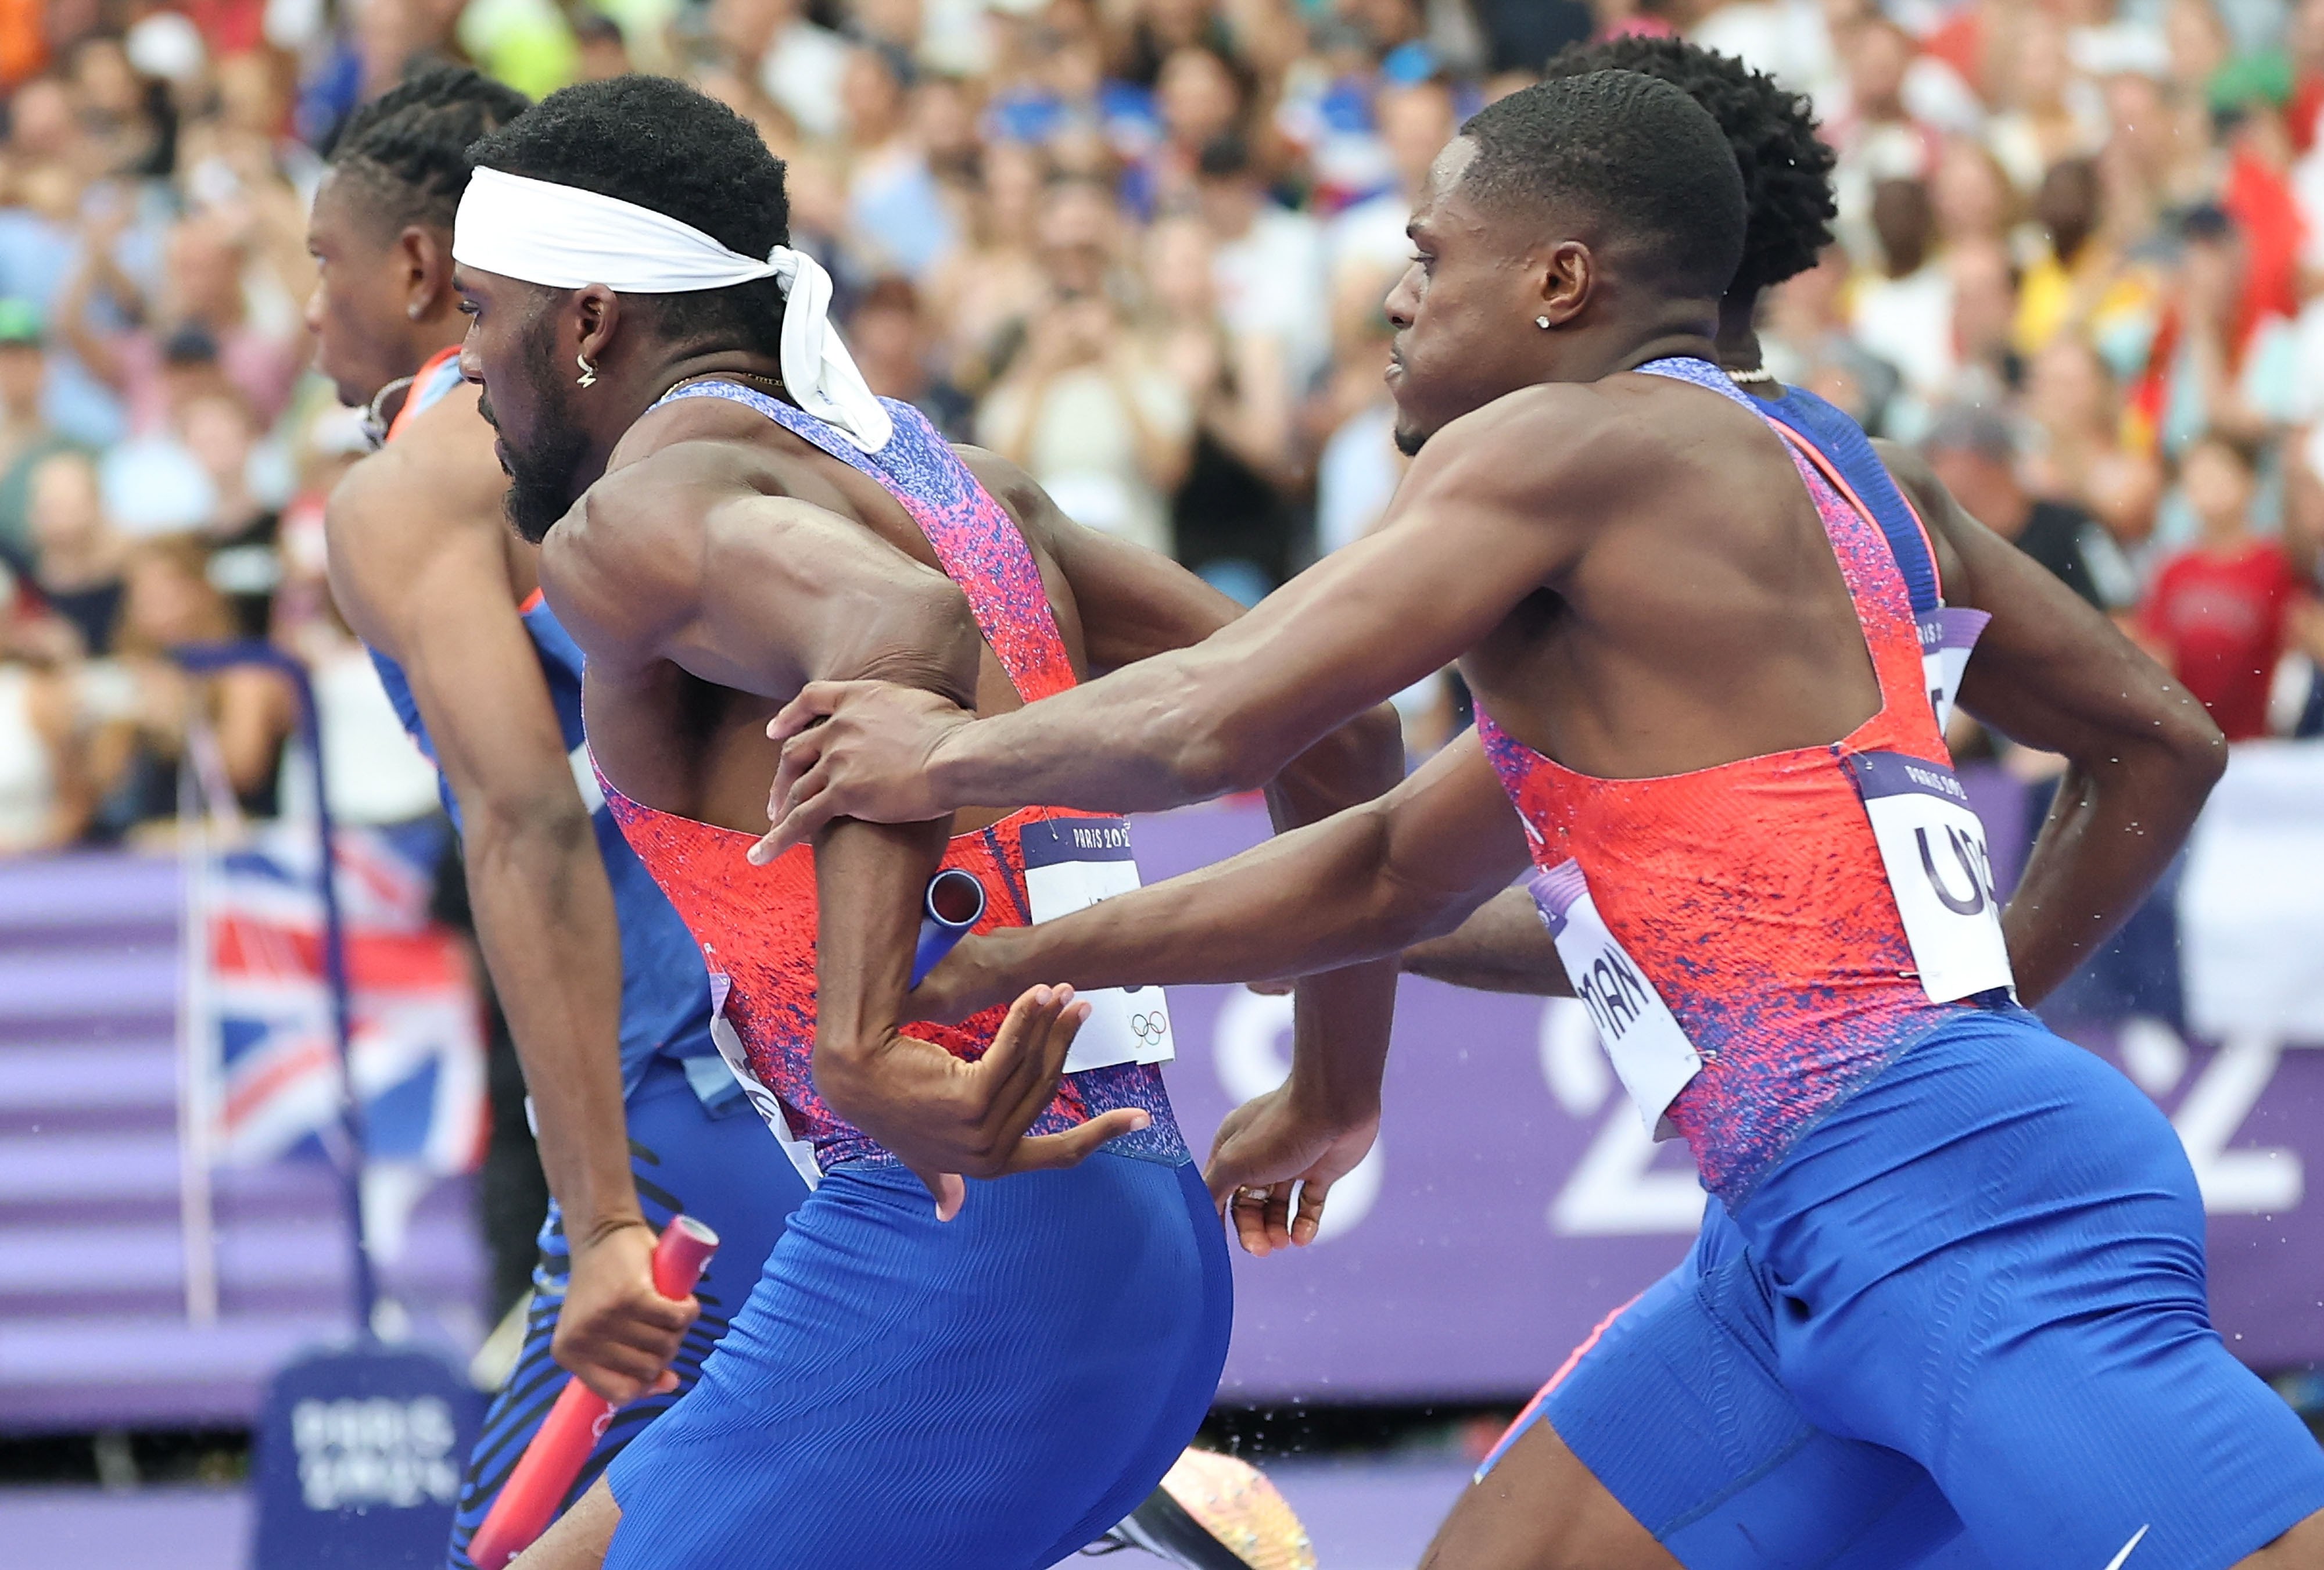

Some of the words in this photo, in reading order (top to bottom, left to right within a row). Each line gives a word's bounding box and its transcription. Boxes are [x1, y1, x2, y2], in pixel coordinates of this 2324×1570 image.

[1905, 765, 1945, 791] PARIS
[1073, 828, 1103, 848] PARIS
[1104, 828, 1131, 848] 202
